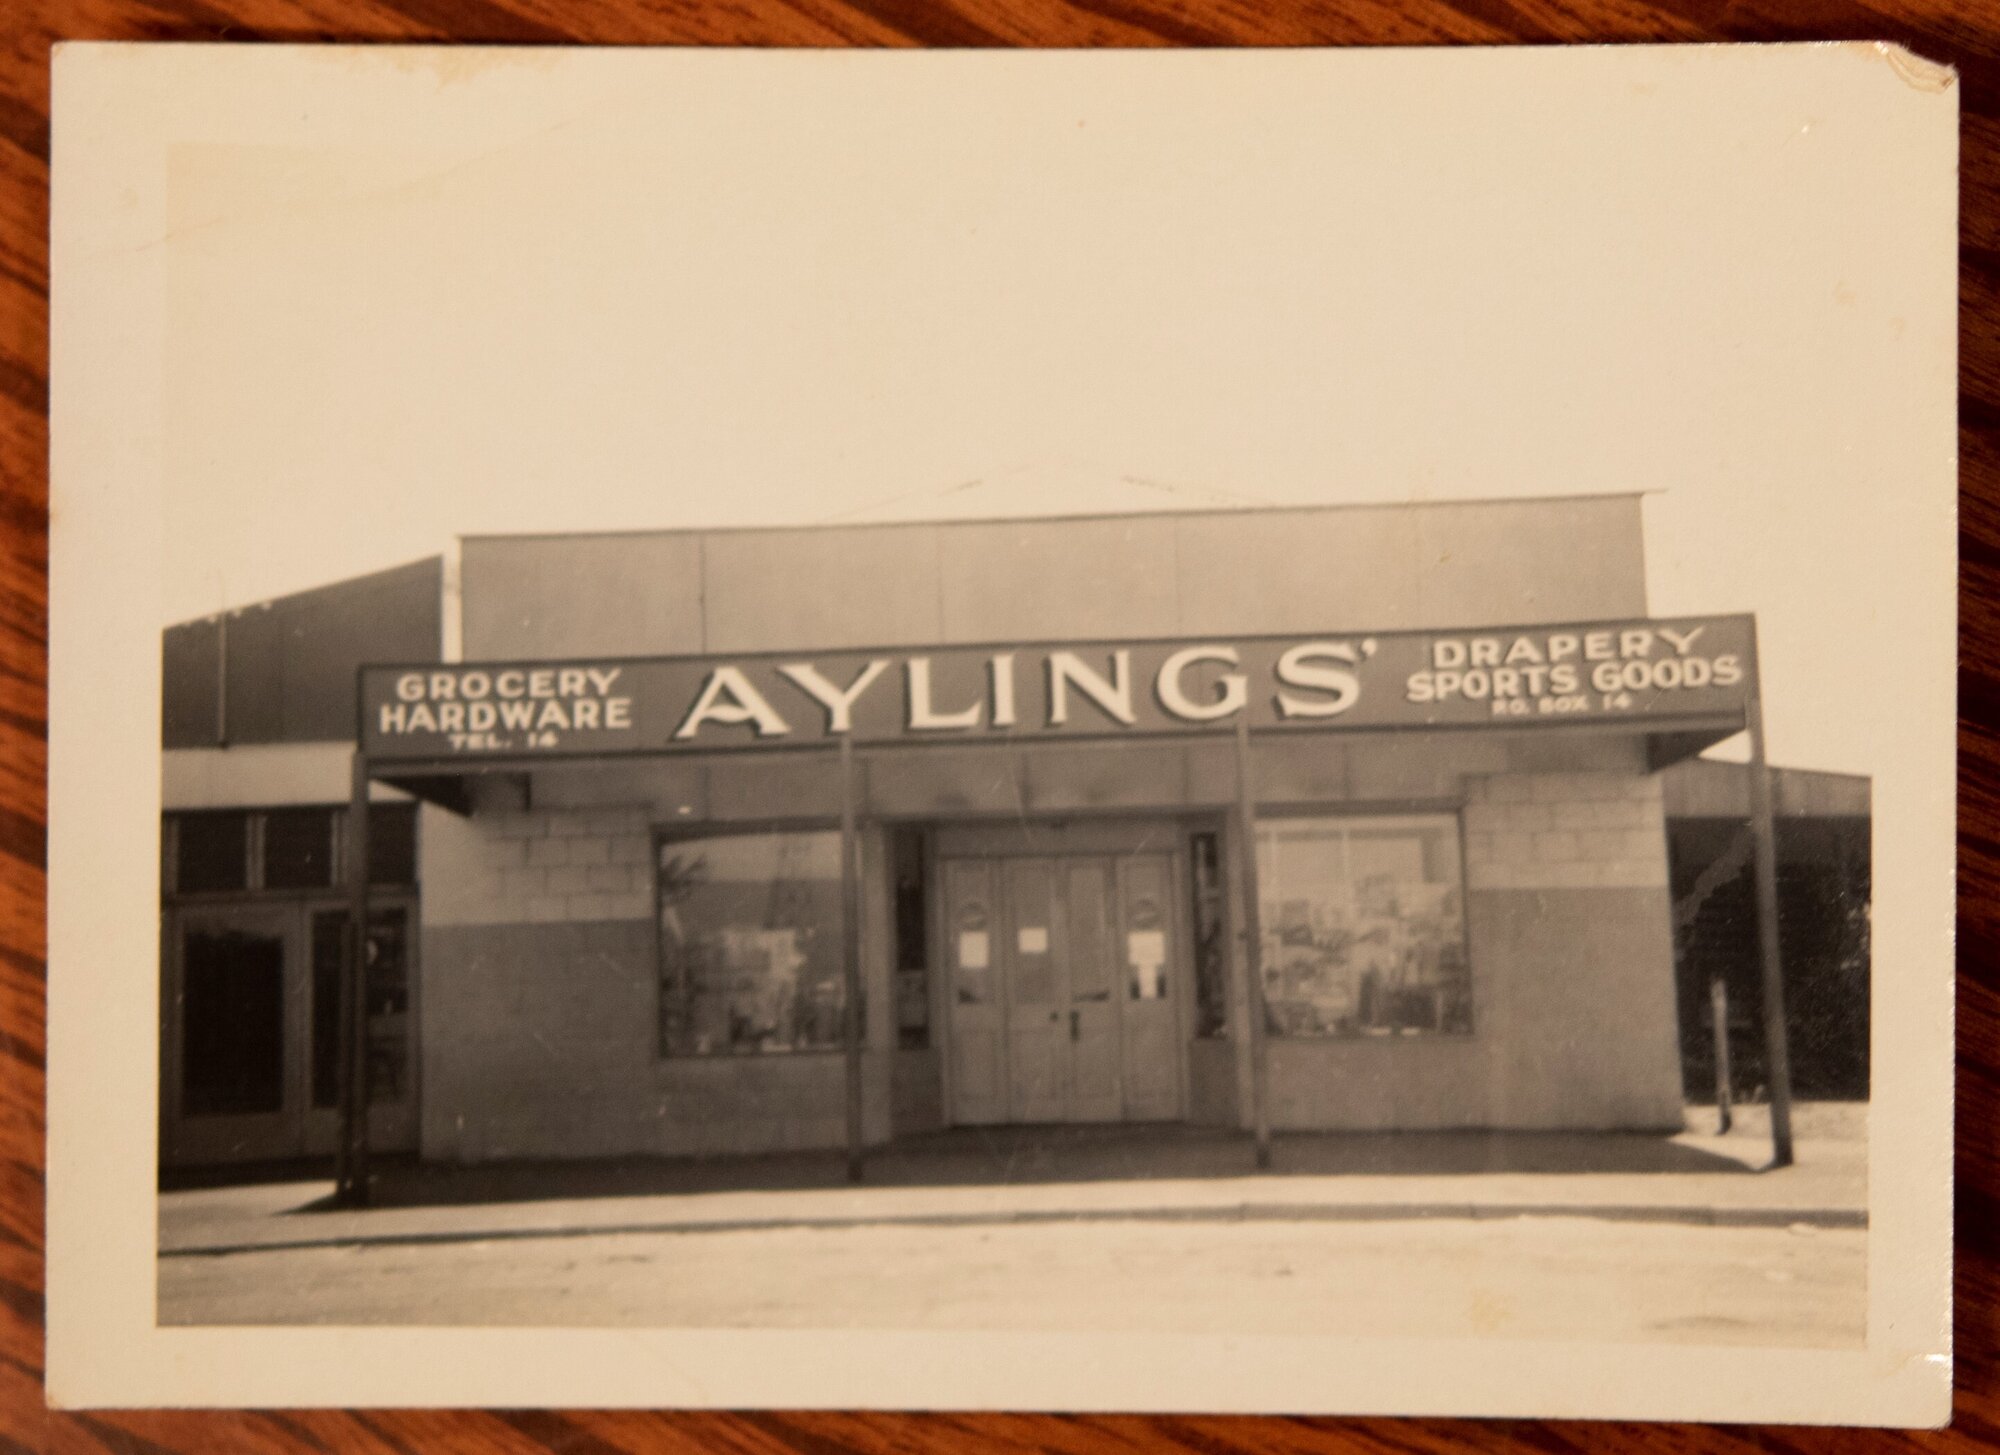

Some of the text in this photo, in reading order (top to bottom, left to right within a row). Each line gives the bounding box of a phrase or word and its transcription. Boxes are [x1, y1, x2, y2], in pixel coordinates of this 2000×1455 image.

[1433, 627, 1706, 669] DRAPERY
[396, 668, 621, 702] GROCERY
[674, 637, 1378, 740] AYLINGS'
[1406, 654, 1743, 703] SPORTS GOODS
[379, 697, 633, 734] HARDWARE
[1538, 694, 1589, 713] BOX
[1602, 692, 1633, 711] 14
[449, 731, 560, 750] TEL. 14
